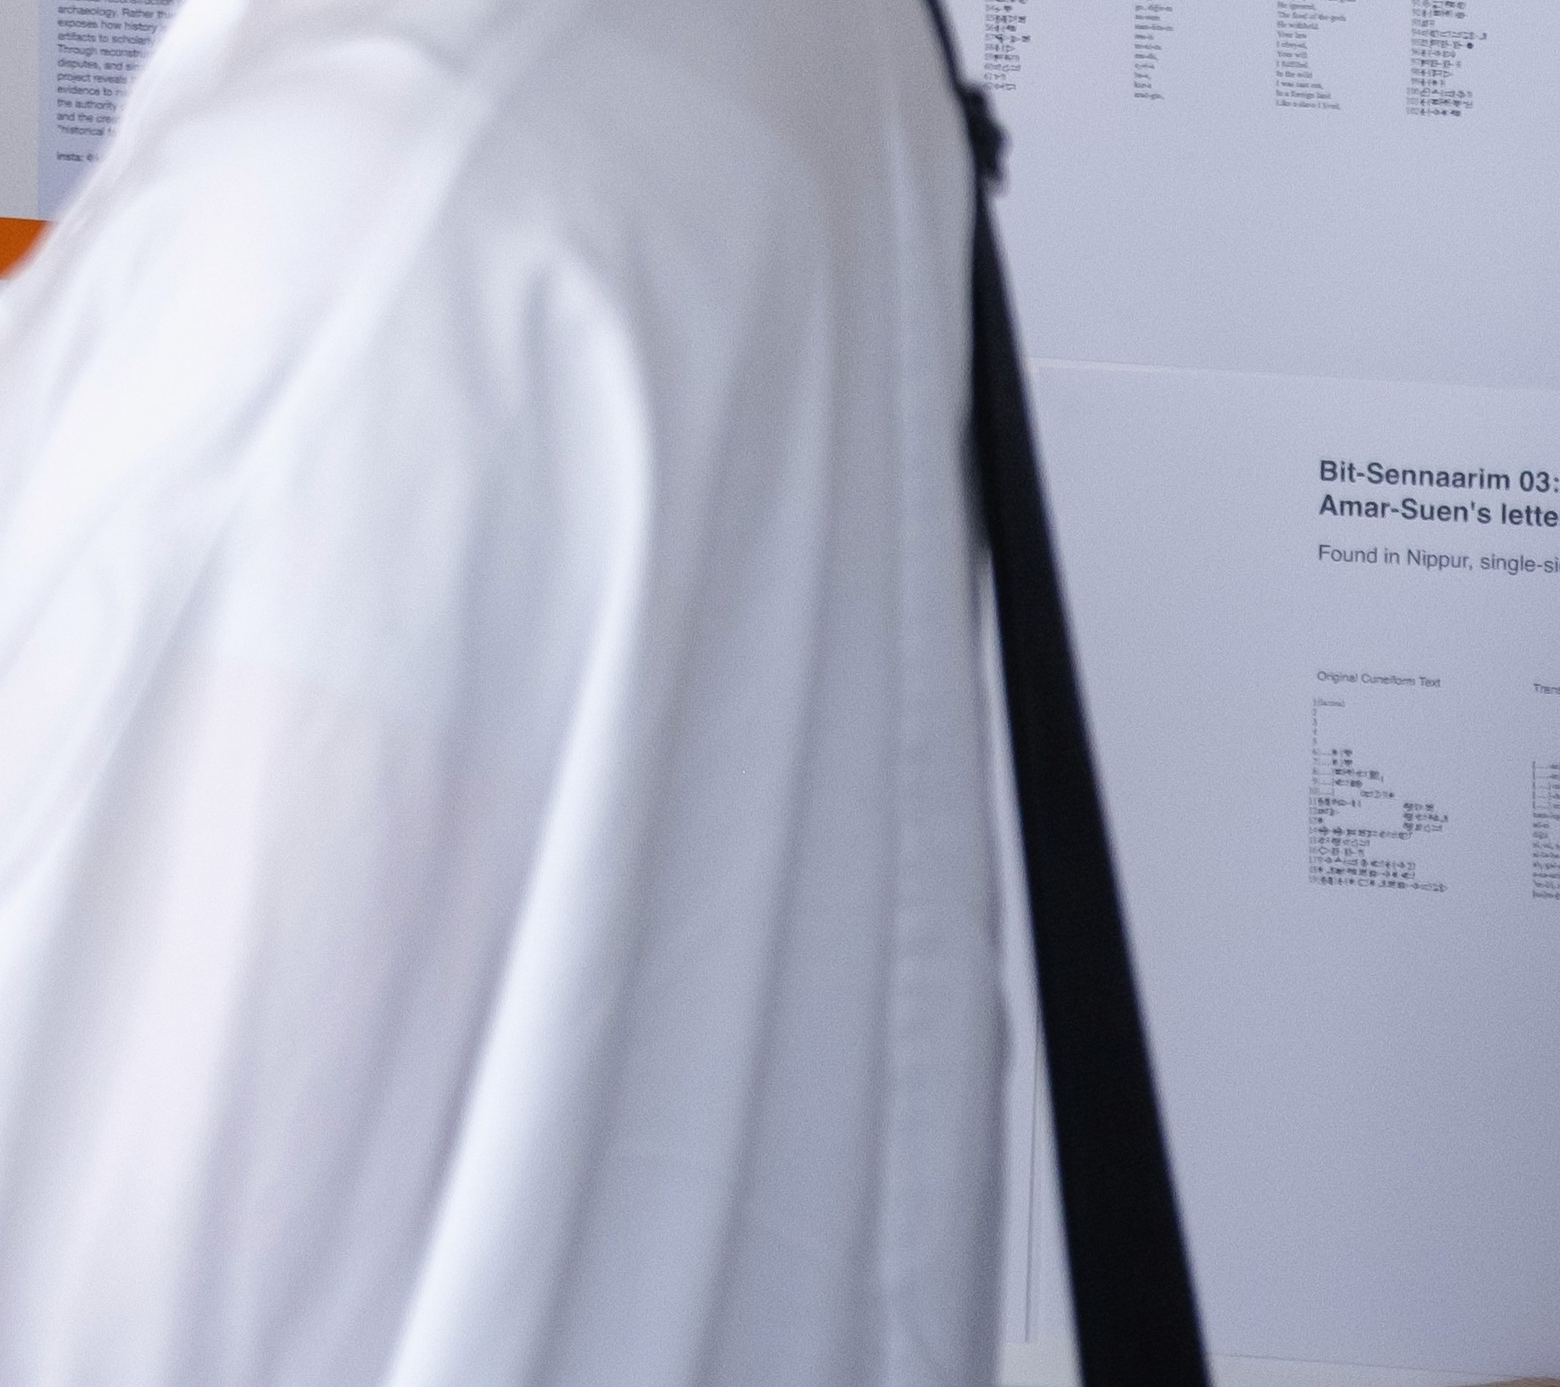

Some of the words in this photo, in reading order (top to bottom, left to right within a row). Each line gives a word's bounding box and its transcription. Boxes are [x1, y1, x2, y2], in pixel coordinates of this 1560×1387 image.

[1321, 460, 1510, 490] Bit-Sennaarim
[1320, 494, 1492, 523] Amar-Suen's
[1502, 503, 1560, 527] lette
[1319, 544, 1378, 563] Found
[1384, 548, 1400, 564] in
[1407, 549, 1473, 571] Nippur,
